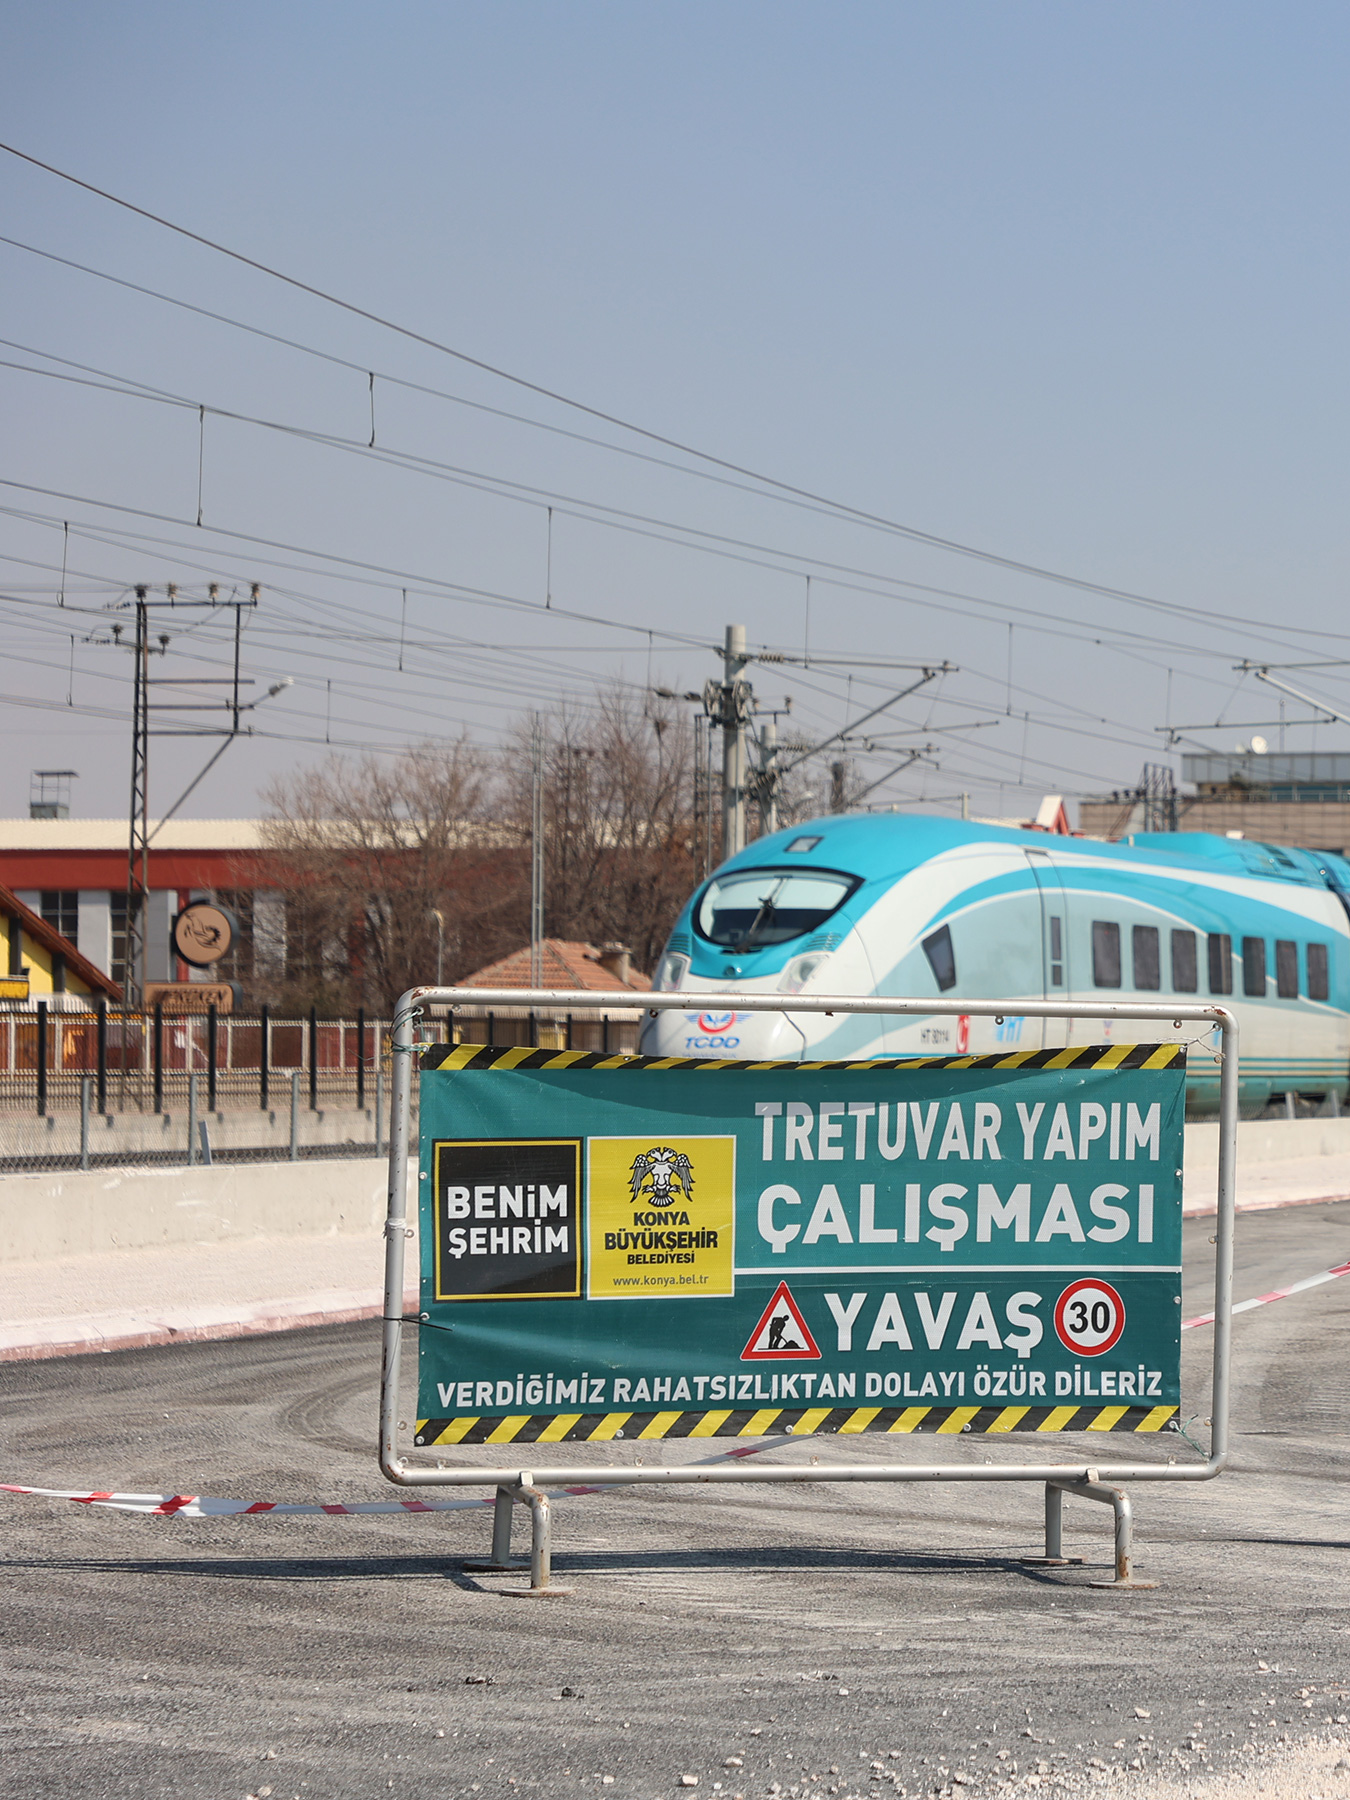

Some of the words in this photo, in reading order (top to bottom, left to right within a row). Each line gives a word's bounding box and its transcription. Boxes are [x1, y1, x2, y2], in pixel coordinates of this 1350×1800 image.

[684, 1036, 741, 1049] TCDD
[755, 1102, 1002, 1161] TRETUVAR
[1015, 1102, 1161, 1161] YAPIM
[633, 1211, 690, 1227] KONYA
[757, 1183, 1155, 1254] ÇALIŞMASI
[448, 1218, 569, 1259] ŞEHRİM
[604, 1226, 719, 1251] BÜYÜKŞEHİR
[627, 1250, 695, 1265] BELEDİYESİ
[612, 1273, 709, 1287] www.konya.bel.tr
[823, 1291, 1044, 1358] YAVAŞ
[1068, 1301, 1111, 1335] 30
[436, 1371, 607, 1408] VERDİĞİMİZ
[612, 1371, 857, 1404] RAHATSIZLIKTAN
[864, 1371, 966, 1398] DOLAYI
[973, 1363, 1047, 1397] ÖZÜR
[1055, 1363, 1163, 1397] DİLERİZ
